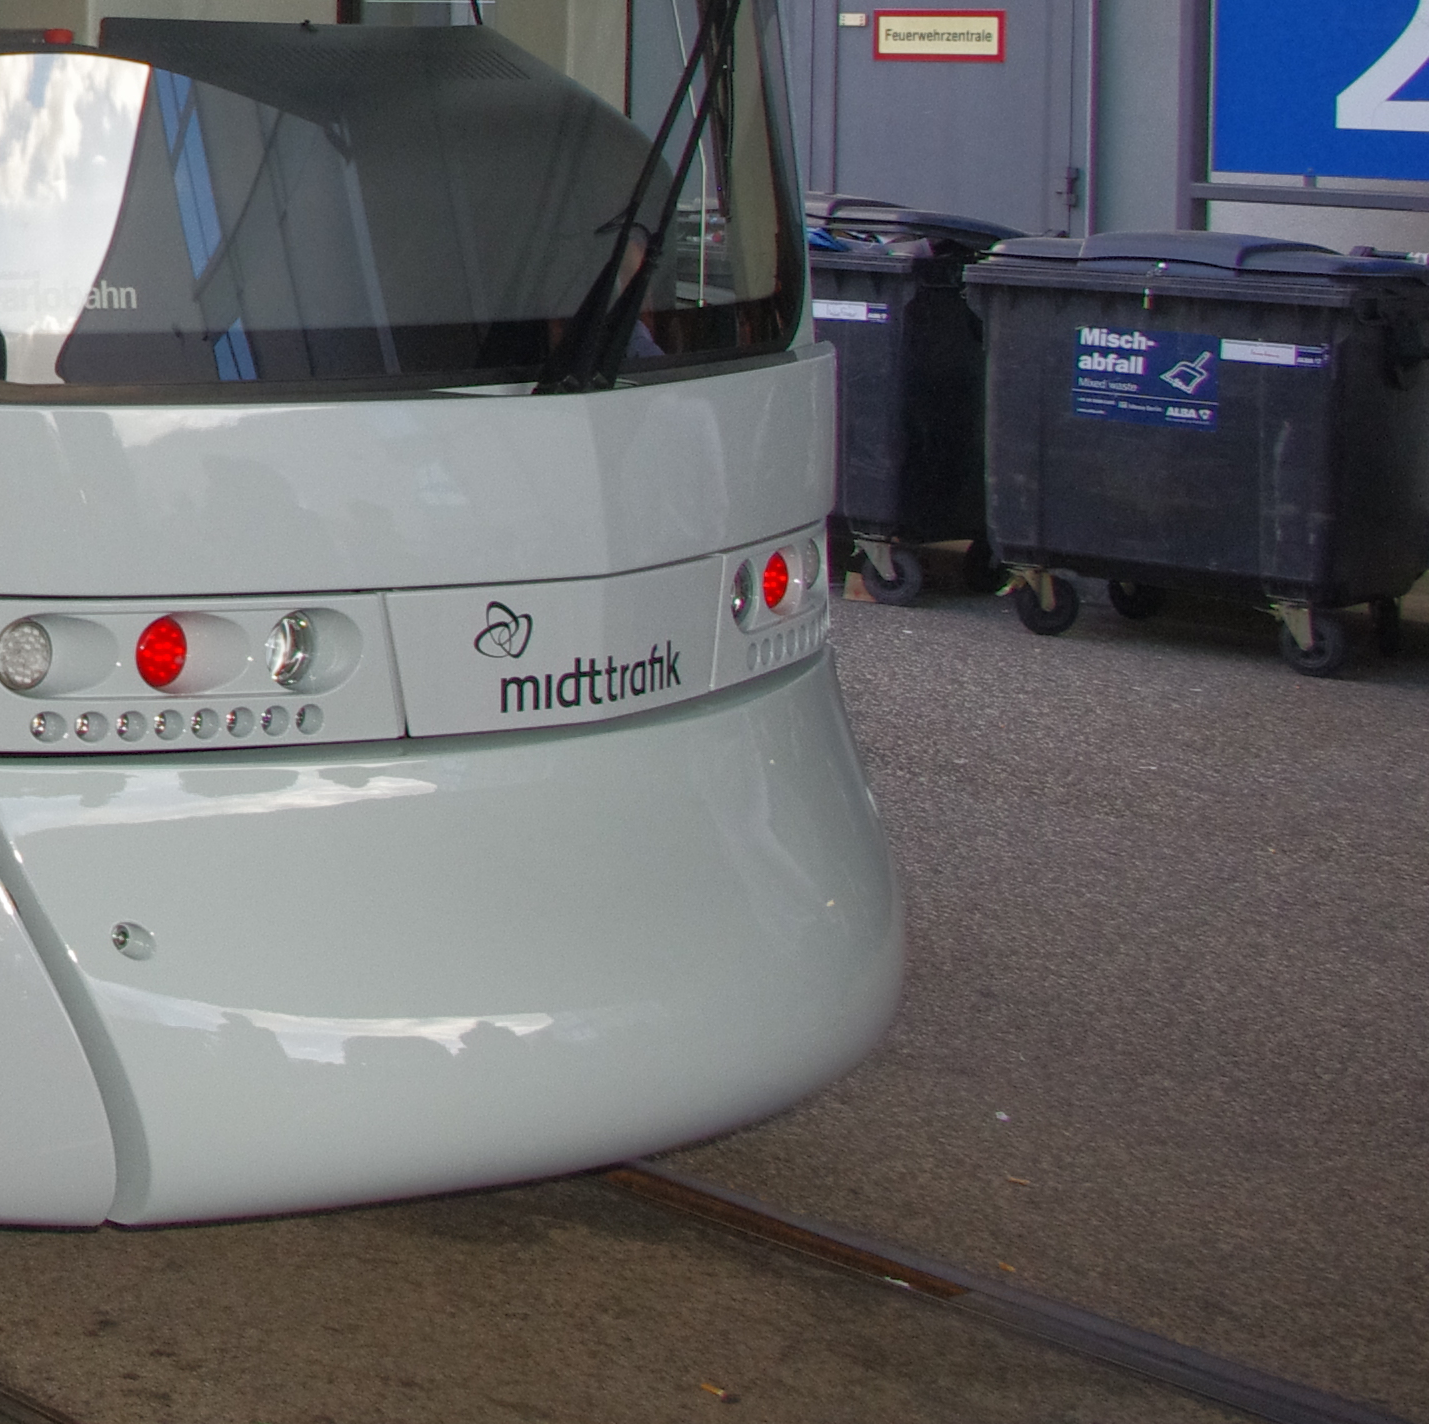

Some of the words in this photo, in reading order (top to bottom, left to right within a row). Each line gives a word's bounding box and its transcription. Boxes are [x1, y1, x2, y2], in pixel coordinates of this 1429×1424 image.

[884, 28, 993, 42] Feuerwehrzentrale
[1079, 327, 1156, 351] Misch-
[1077, 352, 1146, 375] abfall
[1078, 377, 1107, 390] Mixed
[1108, 380, 1139, 393] waste
[1165, 406, 1197, 419] ALBA
[500, 640, 682, 713] midttrafik
